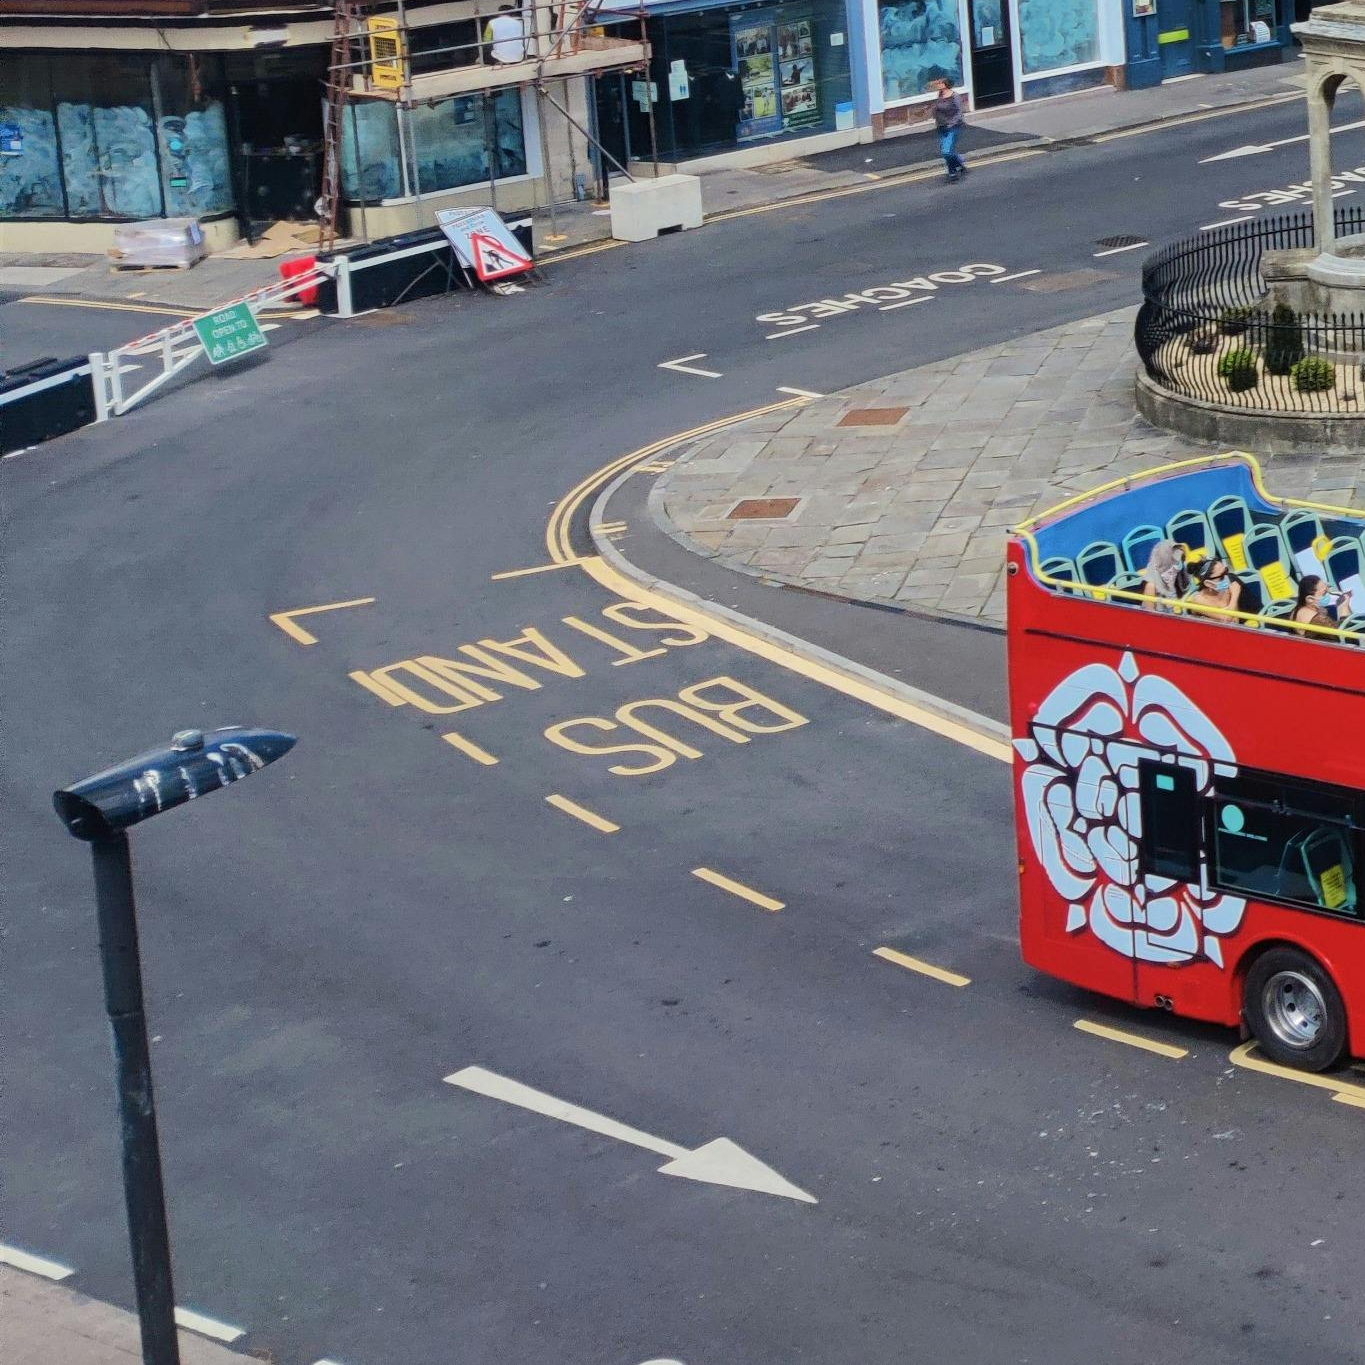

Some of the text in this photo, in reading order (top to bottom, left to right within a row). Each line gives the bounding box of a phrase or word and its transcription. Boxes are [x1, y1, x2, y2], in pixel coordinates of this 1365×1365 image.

[213, 310, 236, 325] ROAD
[756, 263, 1007, 326] COACHES
[212, 319, 247, 338] OPEN TO
[371, 601, 710, 715] STAND
[544, 676, 810, 776] BUS
